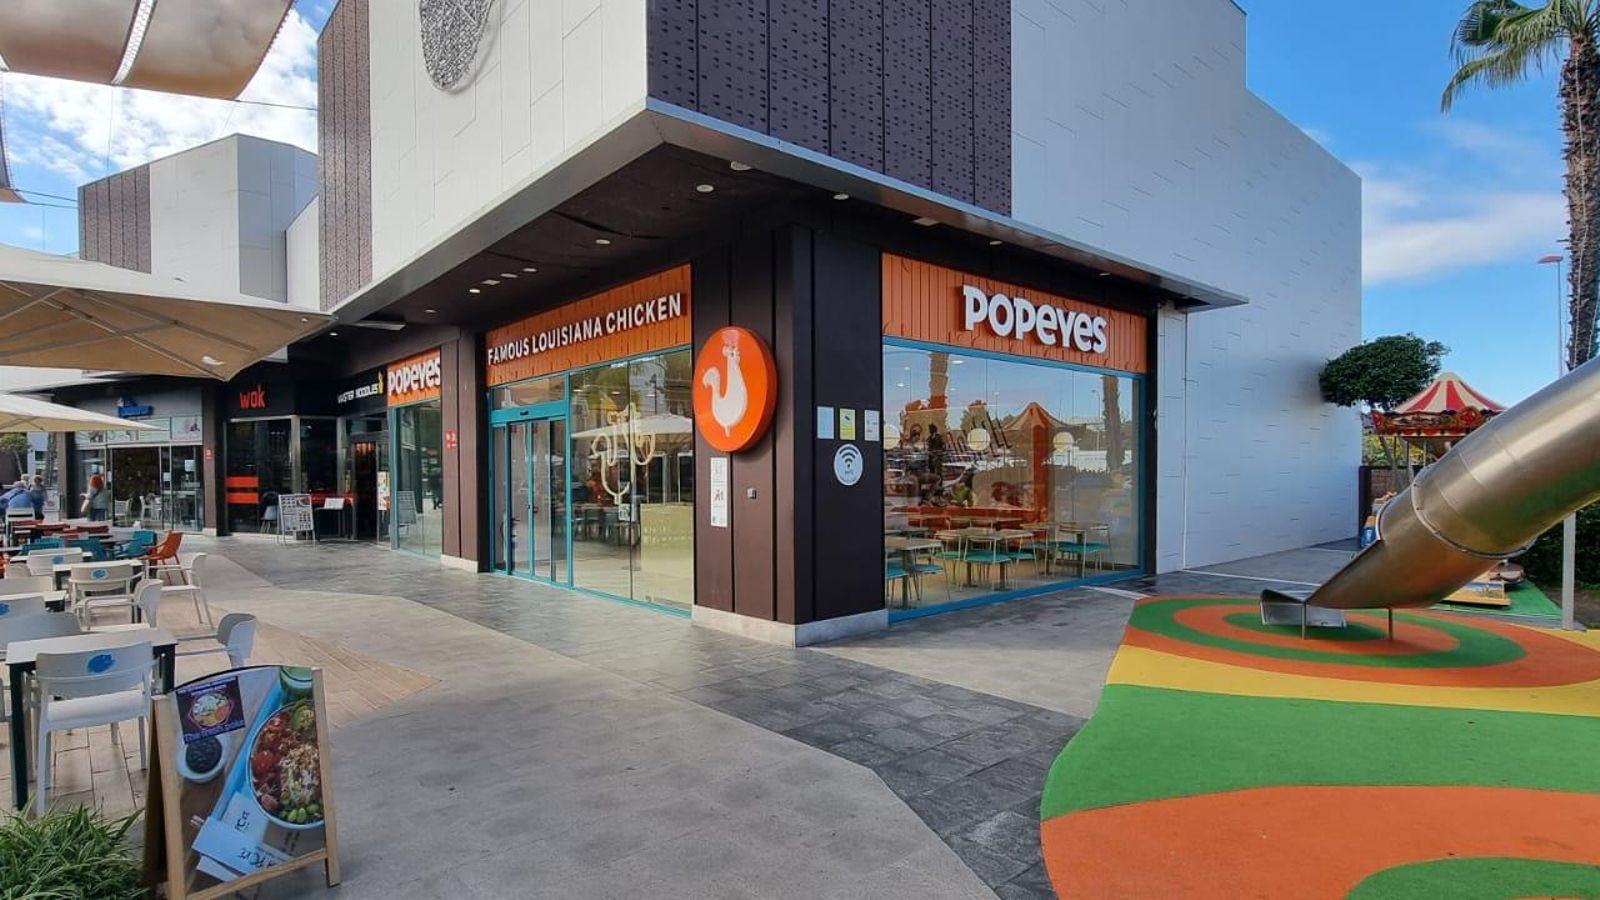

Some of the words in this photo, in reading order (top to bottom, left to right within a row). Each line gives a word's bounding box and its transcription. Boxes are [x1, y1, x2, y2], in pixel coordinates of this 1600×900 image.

[488, 336, 530, 365] FAMOUS
[532, 317, 603, 353] LOUISIANA
[606, 293, 681, 333] CHICKEN
